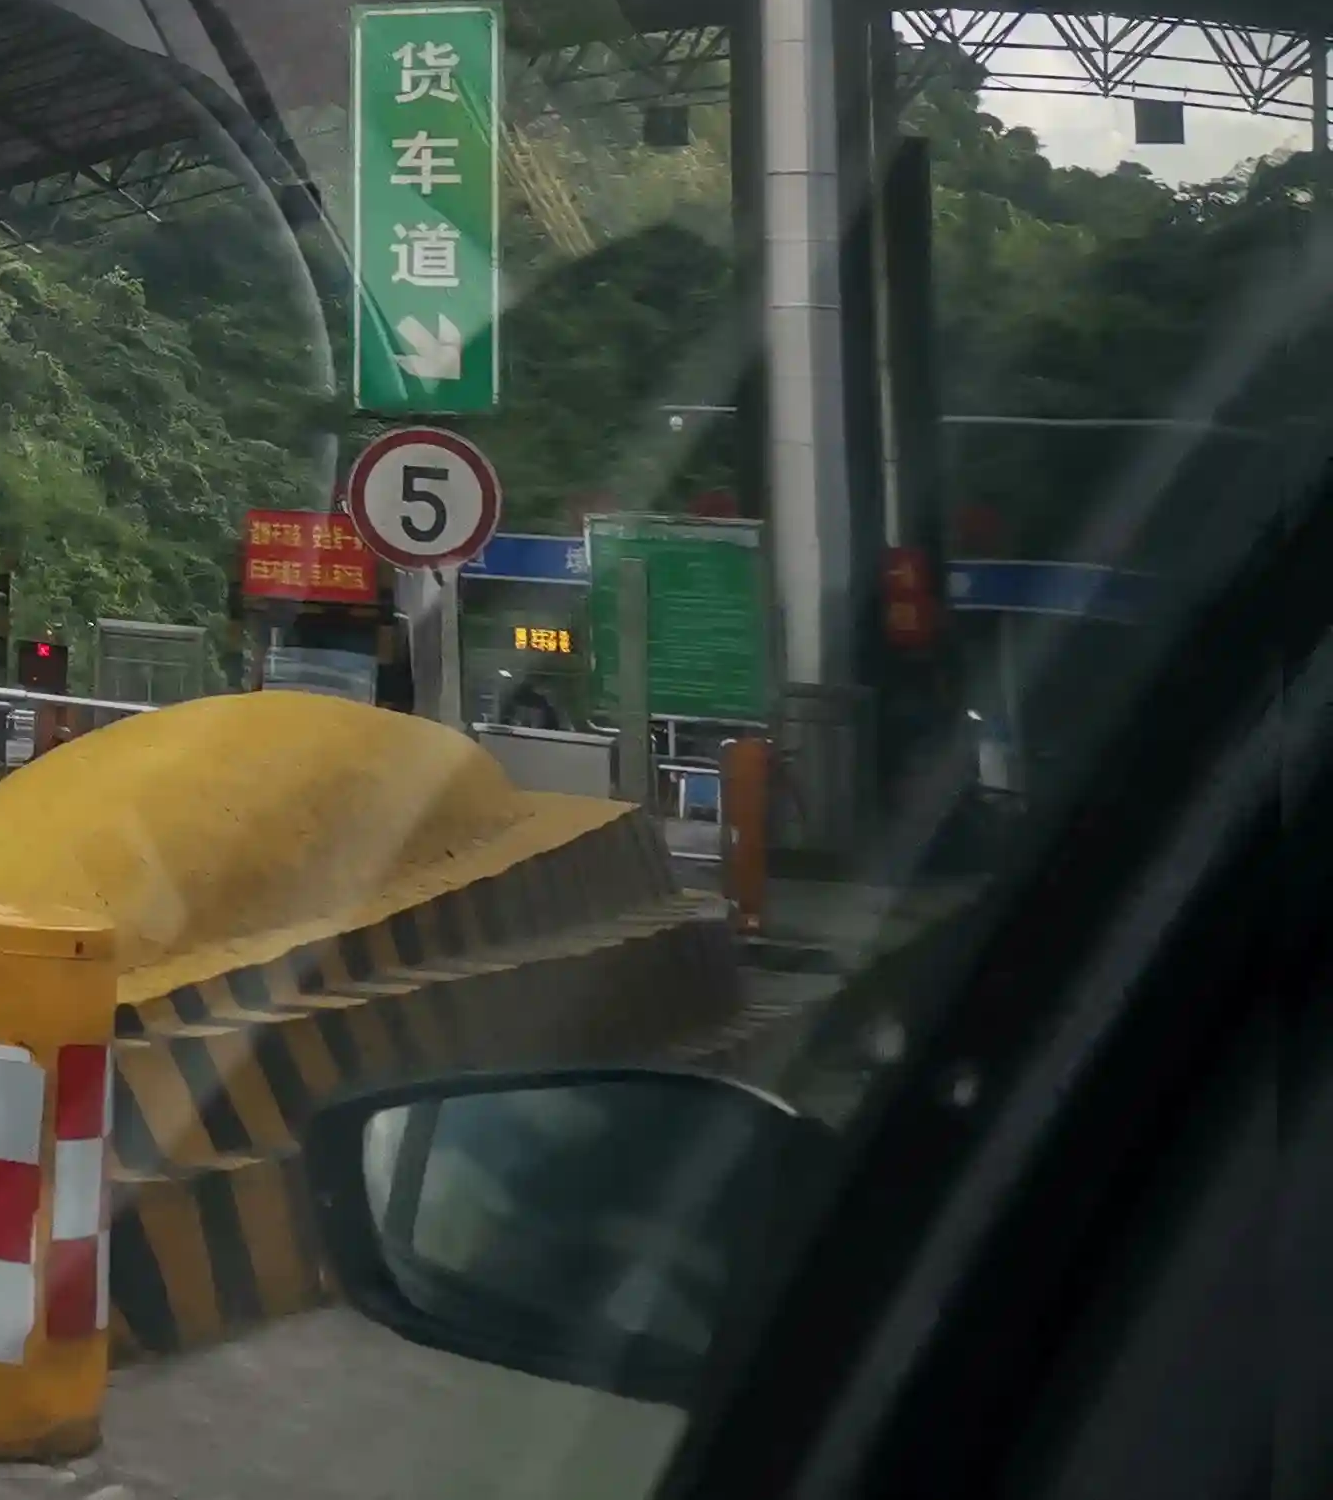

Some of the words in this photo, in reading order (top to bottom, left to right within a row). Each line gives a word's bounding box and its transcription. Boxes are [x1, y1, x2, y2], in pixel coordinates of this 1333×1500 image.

[390, 41, 462, 288] 货车道
[399, 464, 449, 543] 5
